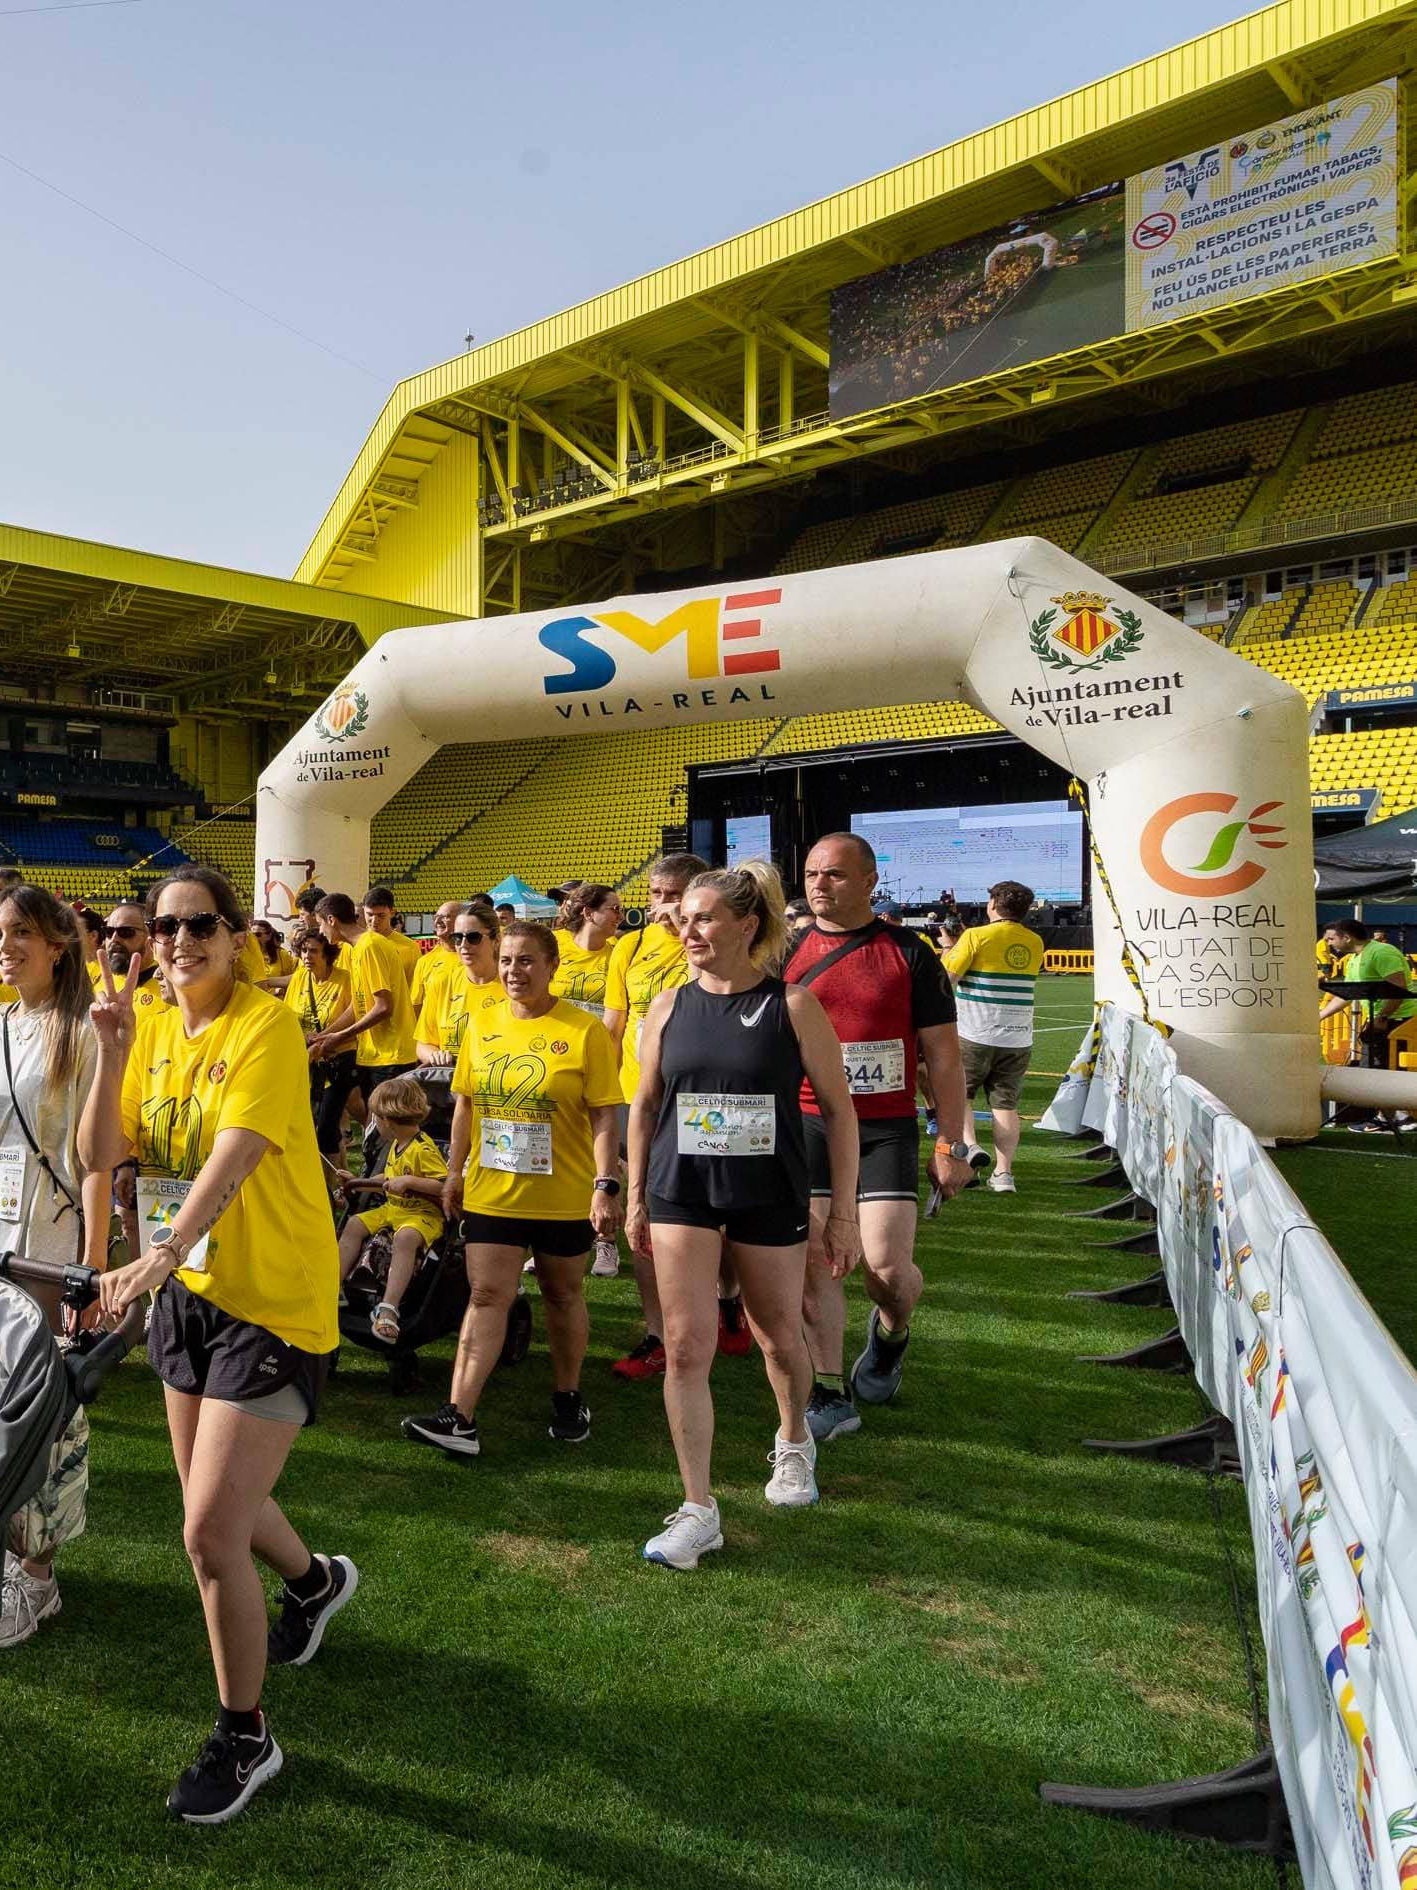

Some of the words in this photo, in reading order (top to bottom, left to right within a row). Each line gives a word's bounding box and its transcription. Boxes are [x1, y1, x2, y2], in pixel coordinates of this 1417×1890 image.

[1208, 159, 1220, 169] DE
[1213, 183, 1270, 209] PROHIBIT
[1275, 166, 1320, 187] FUMAR
[1324, 145, 1383, 170] TABACS,
[1182, 207, 1227, 229] CIGARS
[1330, 155, 1382, 180] VAPERS
[1196, 211, 1290, 251] RESPECTEU
[1295, 200, 1326, 220] LES
[1295, 217, 1317, 232] LA
[1321, 197, 1380, 224] GESPA
[1152, 296, 1174, 311] NO
[1178, 272, 1251, 303] LLANCEU
[1254, 260, 1289, 280] FEM
[1294, 252, 1314, 268] AL
[1320, 234, 1378, 260] TERRA
[1154, 280, 1183, 298] FEU
[1186, 271, 1207, 287] ÚS
[1211, 264, 1232, 281] DE
[1236, 254, 1265, 272] LES
[1269, 221, 1375, 263] PAPERERES,
[538, 588, 782, 695] SME
[555, 684, 776, 719] VILA-REAL
[1009, 671, 1185, 710] Ajuntament
[1340, 686, 1414, 704] PAMESA
[1026, 716, 1043, 727] de
[1042, 695, 1173, 727] Vila-real
[294, 746, 391, 768] Ajuntament
[297, 772, 309, 782] de
[309, 763, 384, 782] Vila-real
[17, 792, 56, 806] PAMESA
[1311, 793, 1361, 808] MESA
[1136, 904, 1286, 931] VILA-REAL
[1138, 937, 1241, 959] CIUTAT
[1249, 936, 1286, 957] DE
[1141, 965, 1181, 984] LA
[1189, 962, 1286, 984] SALUT
[1158, 987, 1288, 1009] L'ESPORT
[485, 1052, 546, 1108] 12
[160, 1185, 186, 1196] CELTIC
